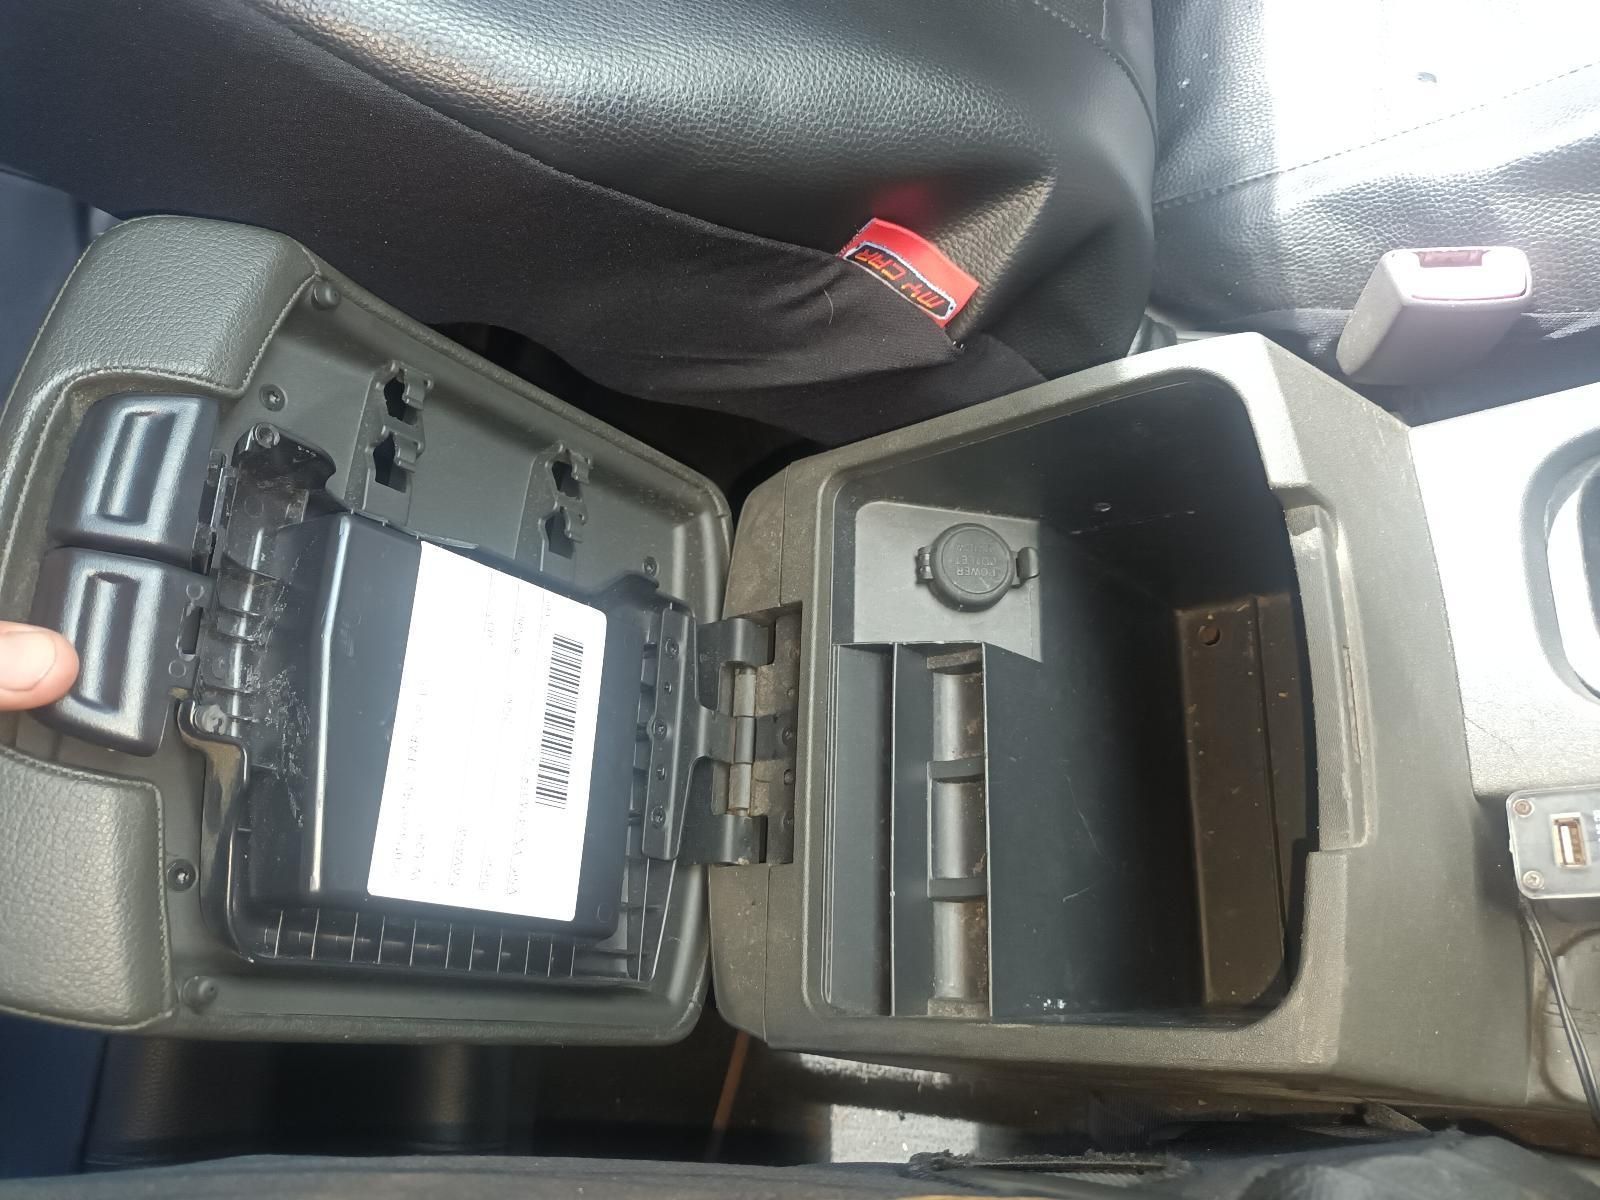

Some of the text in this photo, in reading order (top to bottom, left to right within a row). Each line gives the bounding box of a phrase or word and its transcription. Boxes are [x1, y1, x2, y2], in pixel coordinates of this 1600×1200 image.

[855, 250, 945, 309] MY CAR
[956, 567, 996, 577] POWER
